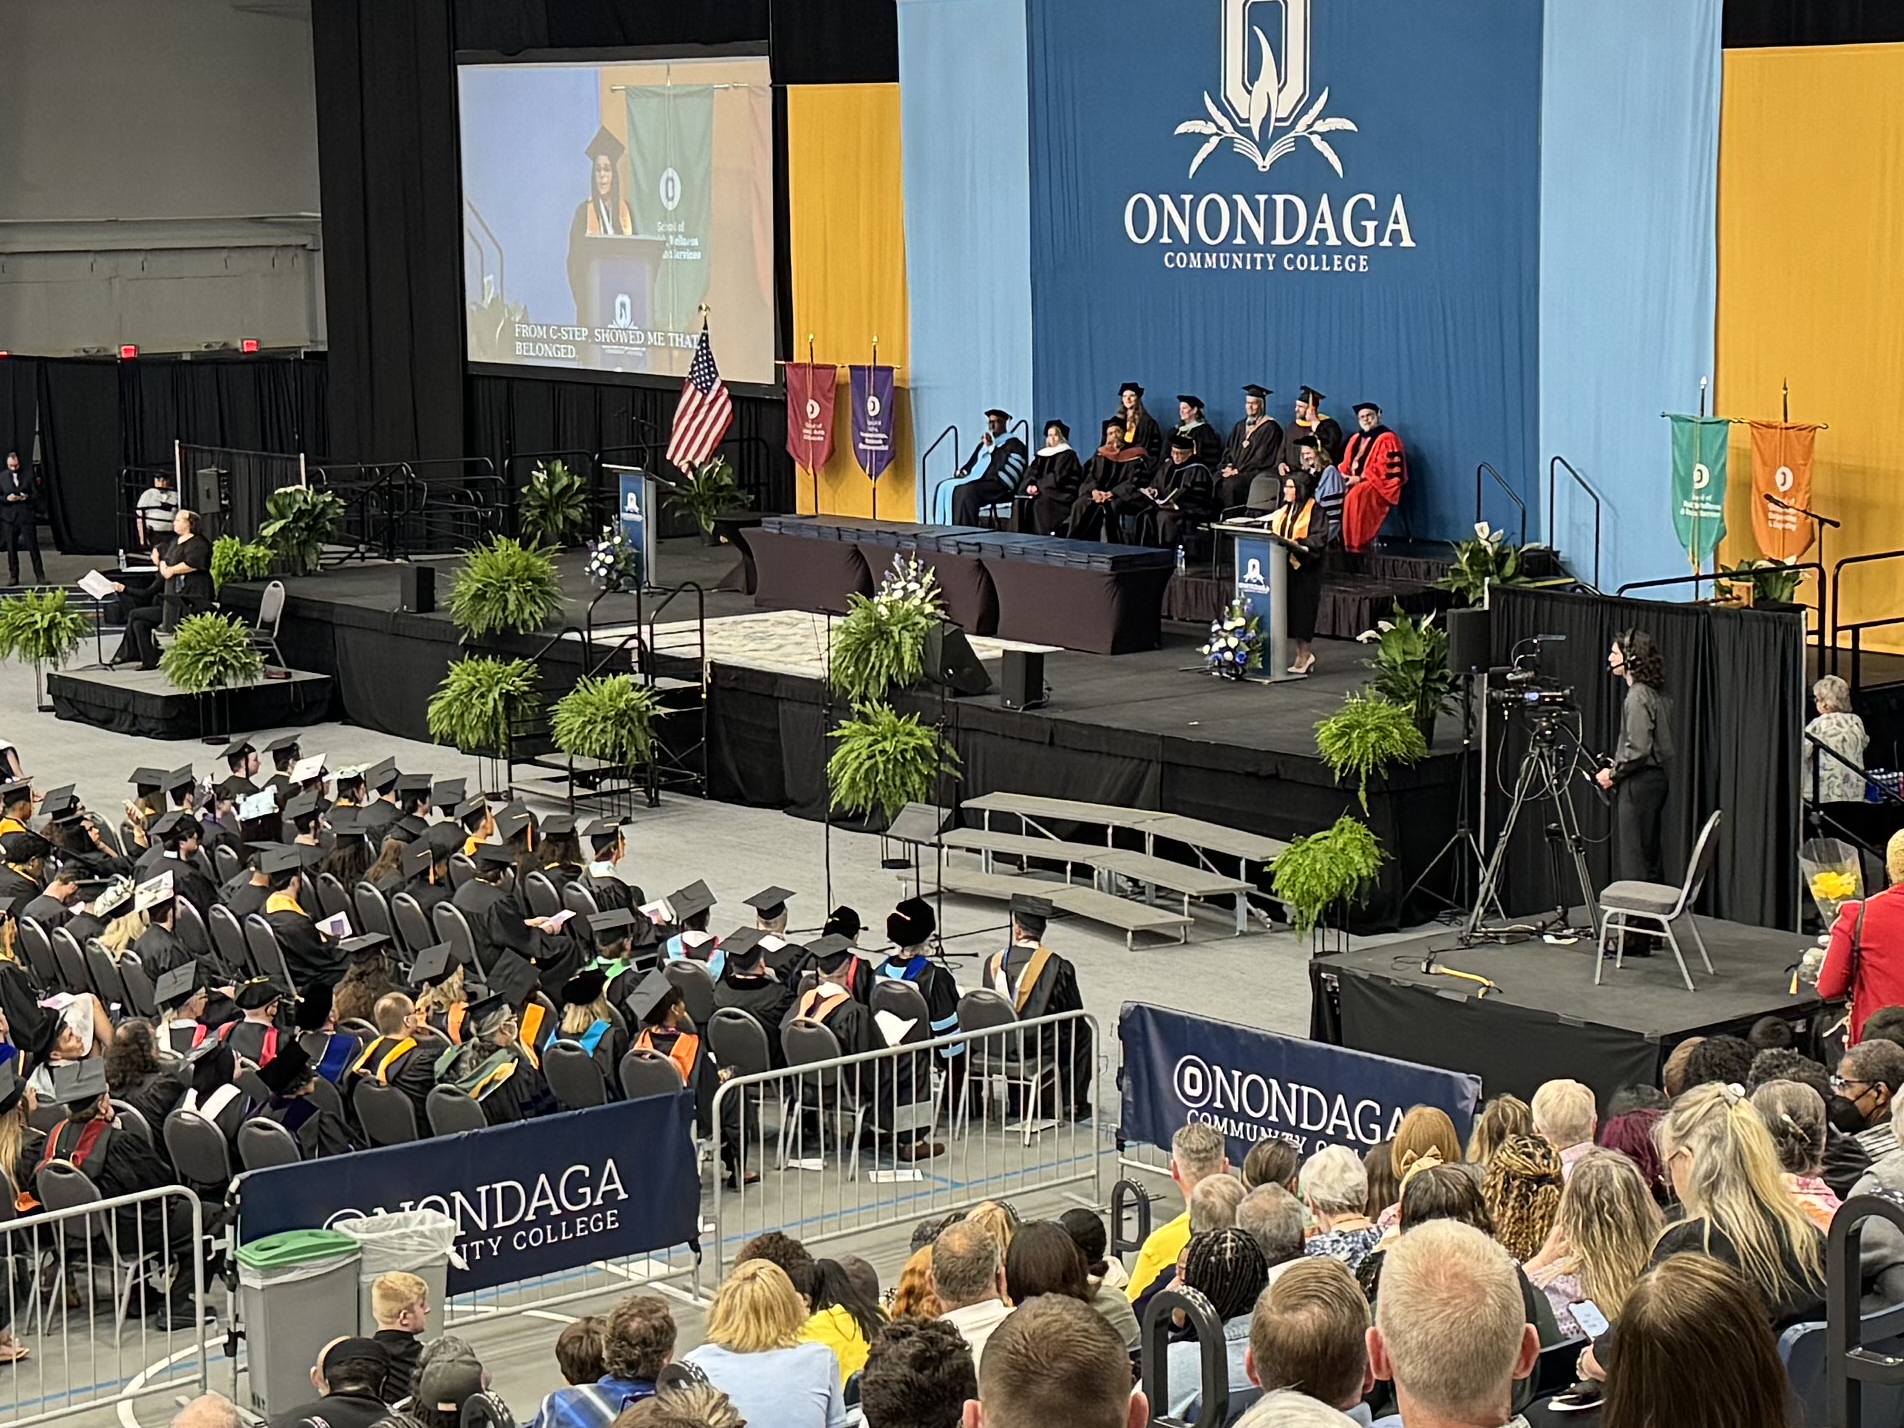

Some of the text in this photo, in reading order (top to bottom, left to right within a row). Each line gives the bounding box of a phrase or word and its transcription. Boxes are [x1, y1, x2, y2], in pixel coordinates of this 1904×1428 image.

[1124, 192, 1417, 248] ONONDAGA
[1164, 251, 1369, 272] COMMUNITY COLLEGE
[515, 324, 547, 339] FROM
[594, 328, 645, 344] SHOWED
[647, 331, 665, 347] ME
[512, 1209, 620, 1251] COLLEGE
